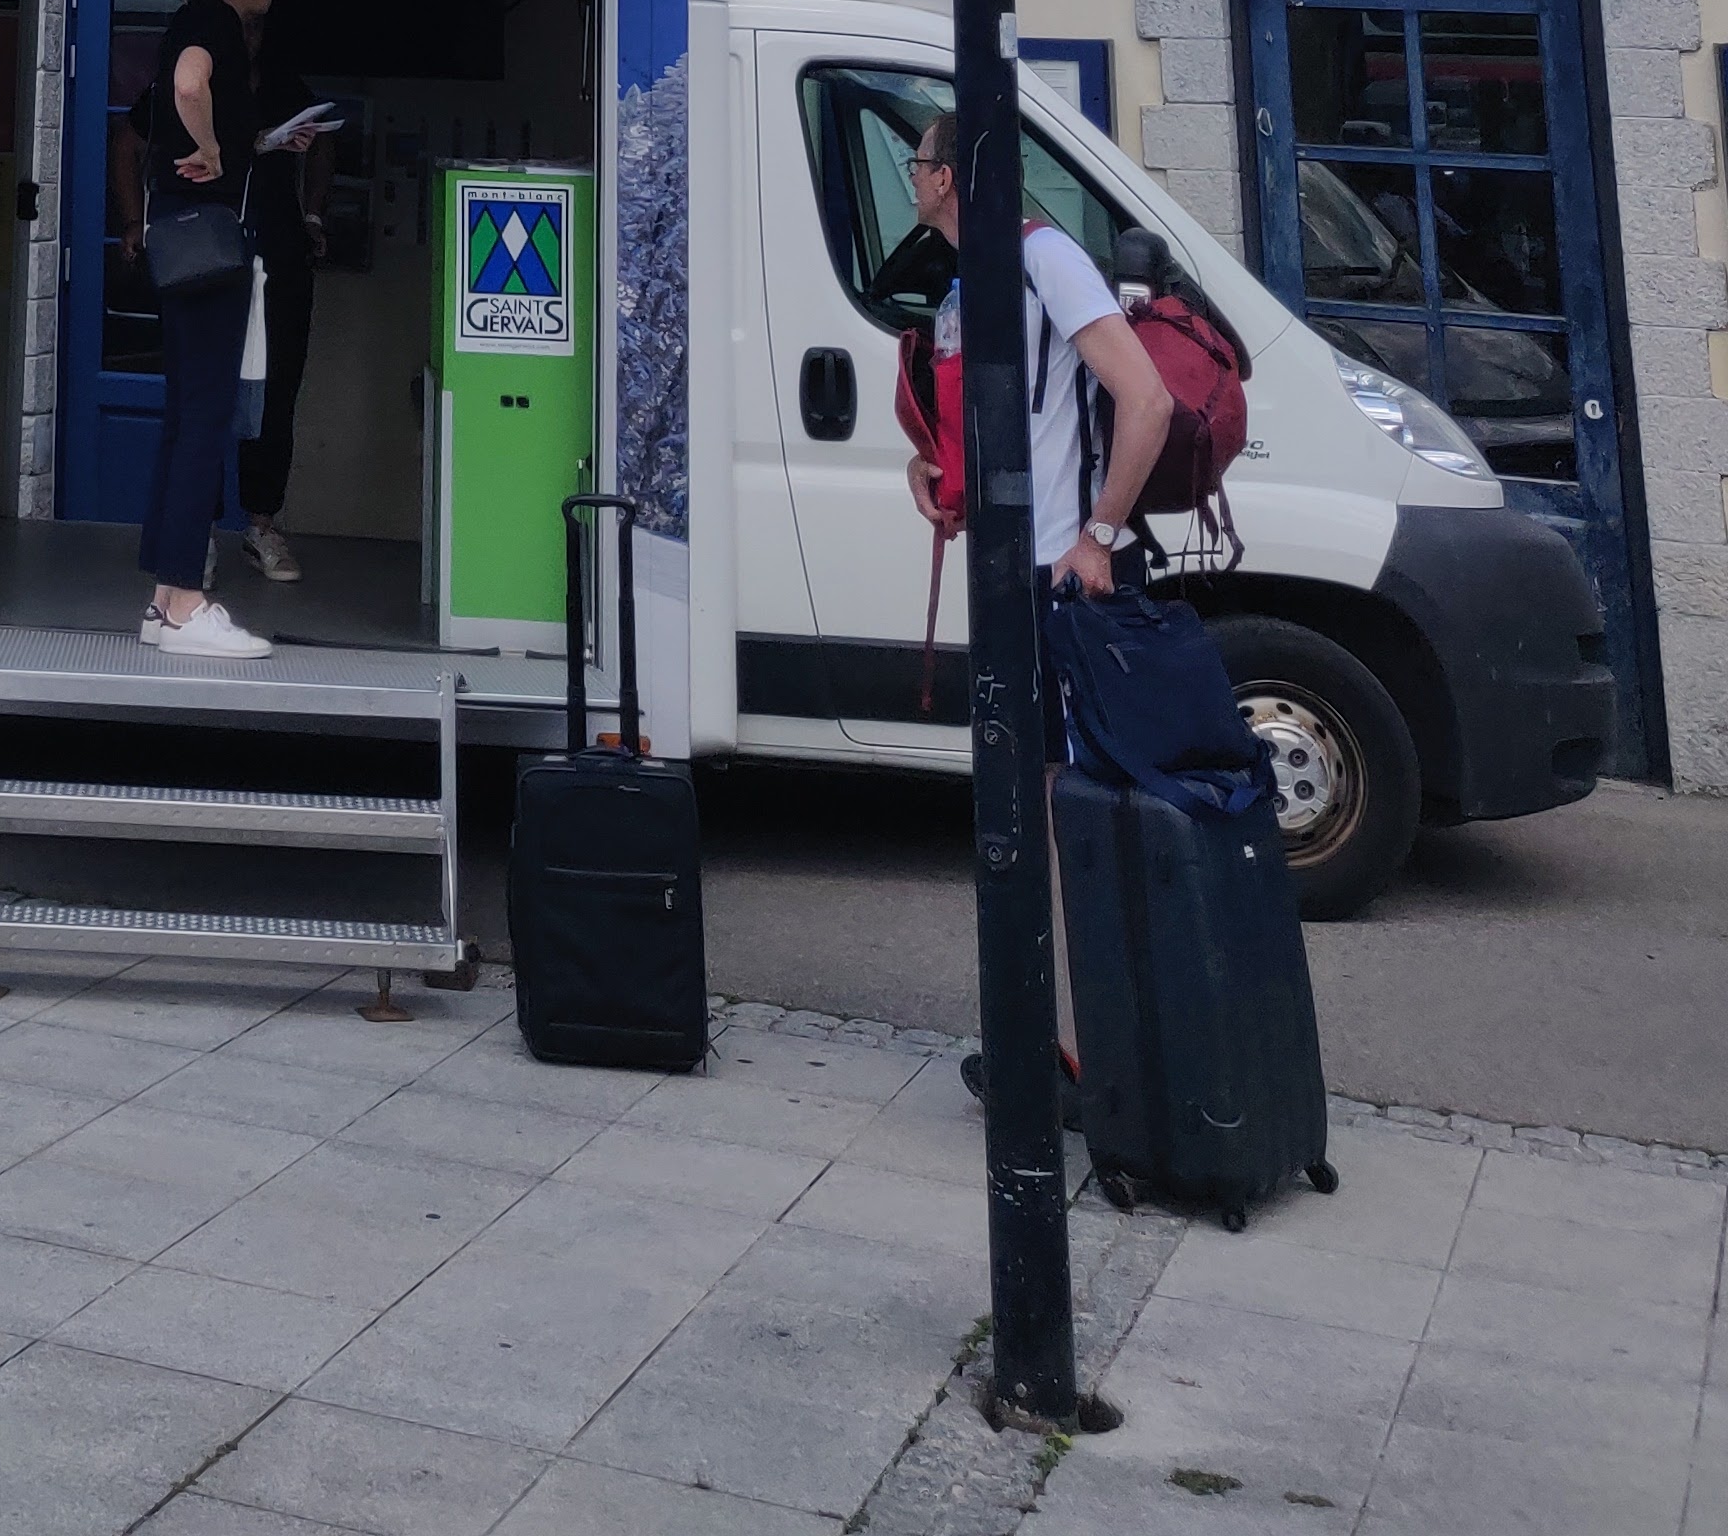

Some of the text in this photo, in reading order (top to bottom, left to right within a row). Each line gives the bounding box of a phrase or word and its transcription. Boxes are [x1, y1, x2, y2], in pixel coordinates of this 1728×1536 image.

[467, 191, 564, 202] mont-blanc
[466, 297, 564, 336] GERVAIS
[489, 297, 545, 317] SAINT
